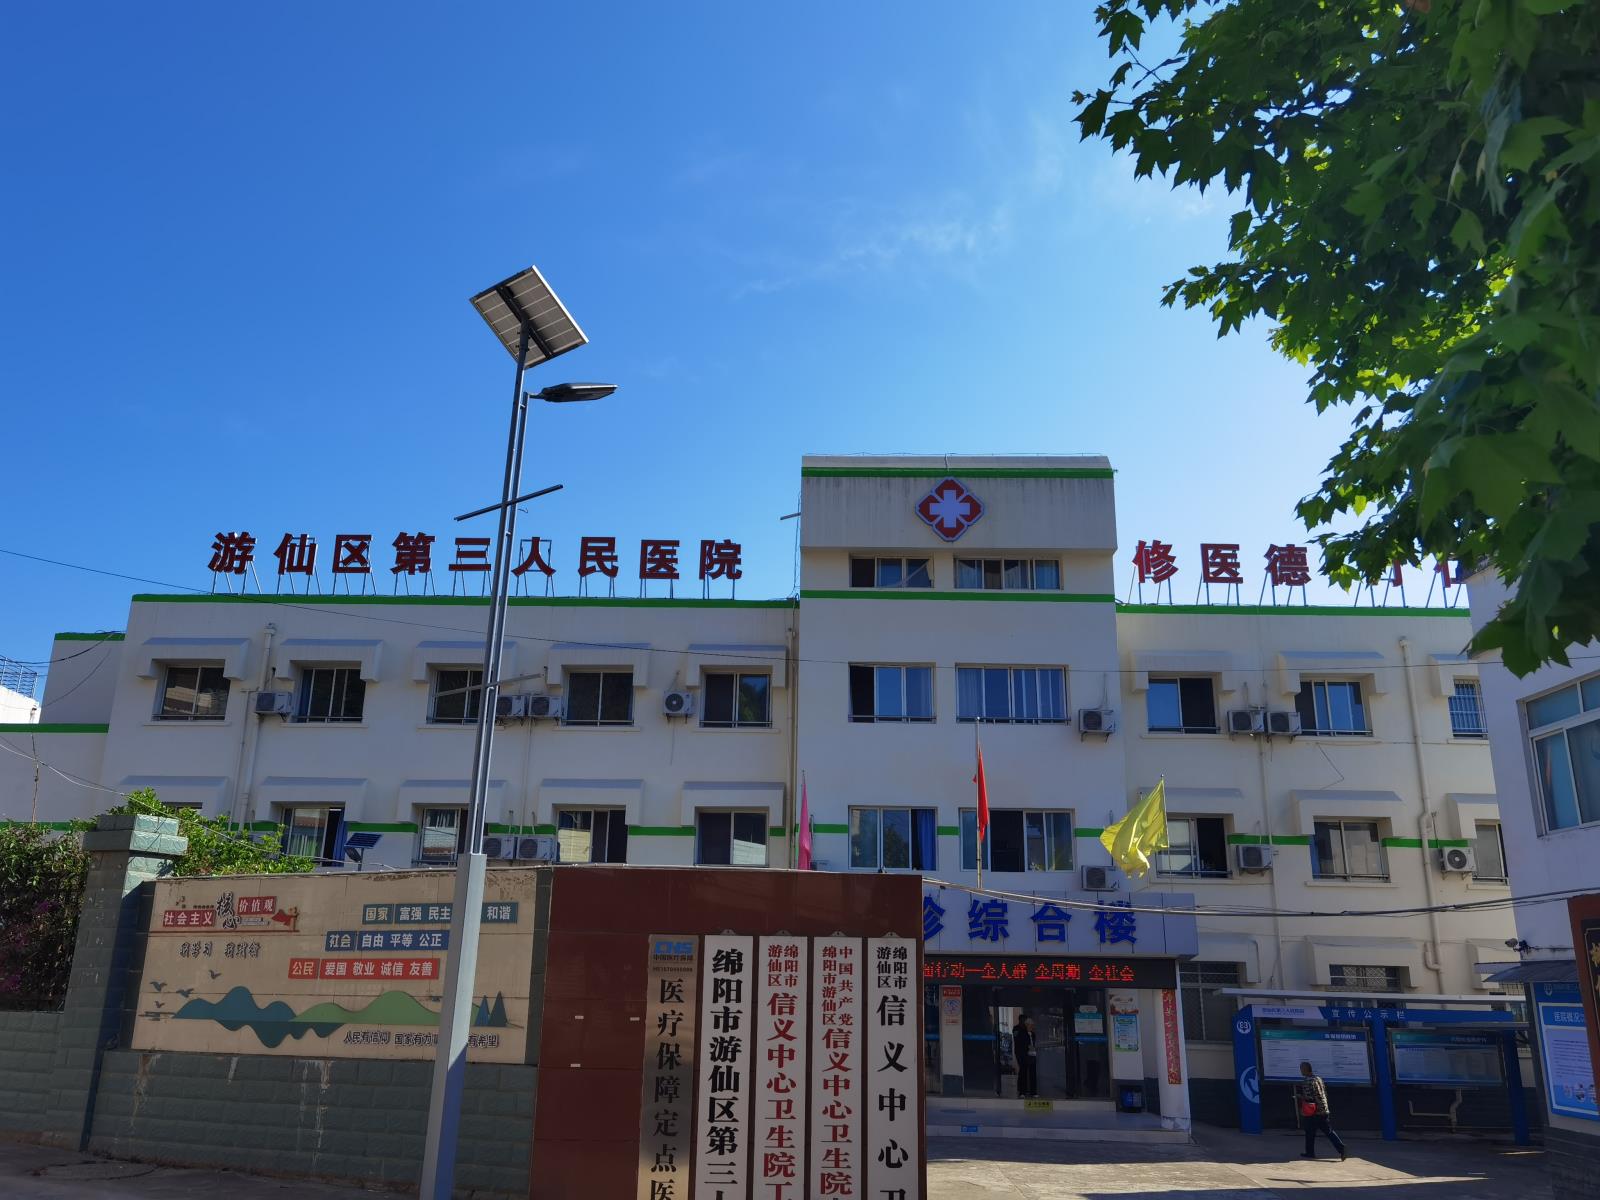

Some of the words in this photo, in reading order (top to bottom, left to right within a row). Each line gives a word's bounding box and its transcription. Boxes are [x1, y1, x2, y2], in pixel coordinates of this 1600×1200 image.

[207, 532, 742, 580] 游仙区第三人民医院
[163, 911, 213, 926] 社会主义
[239, 898, 275, 912] 价值观
[365, 907, 389, 921] 国家
[399, 906, 422, 920] 富强
[428, 906, 450, 920] 民主
[487, 906, 512, 920] 和谐
[329, 934, 351, 947] 社会
[361, 934, 384, 947] 自由
[390, 934, 413, 947] 平等
[419, 934, 442, 947] 公正
[292, 963, 314, 975] 公民
[324, 962, 347, 975] 爱国
[352, 962, 375, 975] 敬业
[380, 962, 404, 975] 诚信
[409, 962, 433, 975] 友善
[768, 944, 783, 987] 游仙区
[784, 944, 799, 987] 绵阳市
[822, 946, 837, 1026] 绵阳市游仙区
[838, 946, 854, 1026] 中国共产党
[876, 946, 892, 989] 游仙区
[892, 946, 907, 990] 绵阳市
[1034, 963, 1081, 981] 全周期
[1088, 964, 1135, 982] 全社会
[650, 978, 685, 1200] 医疗保障定点医
[820, 1028, 852, 1200] 信义中心卫生院
